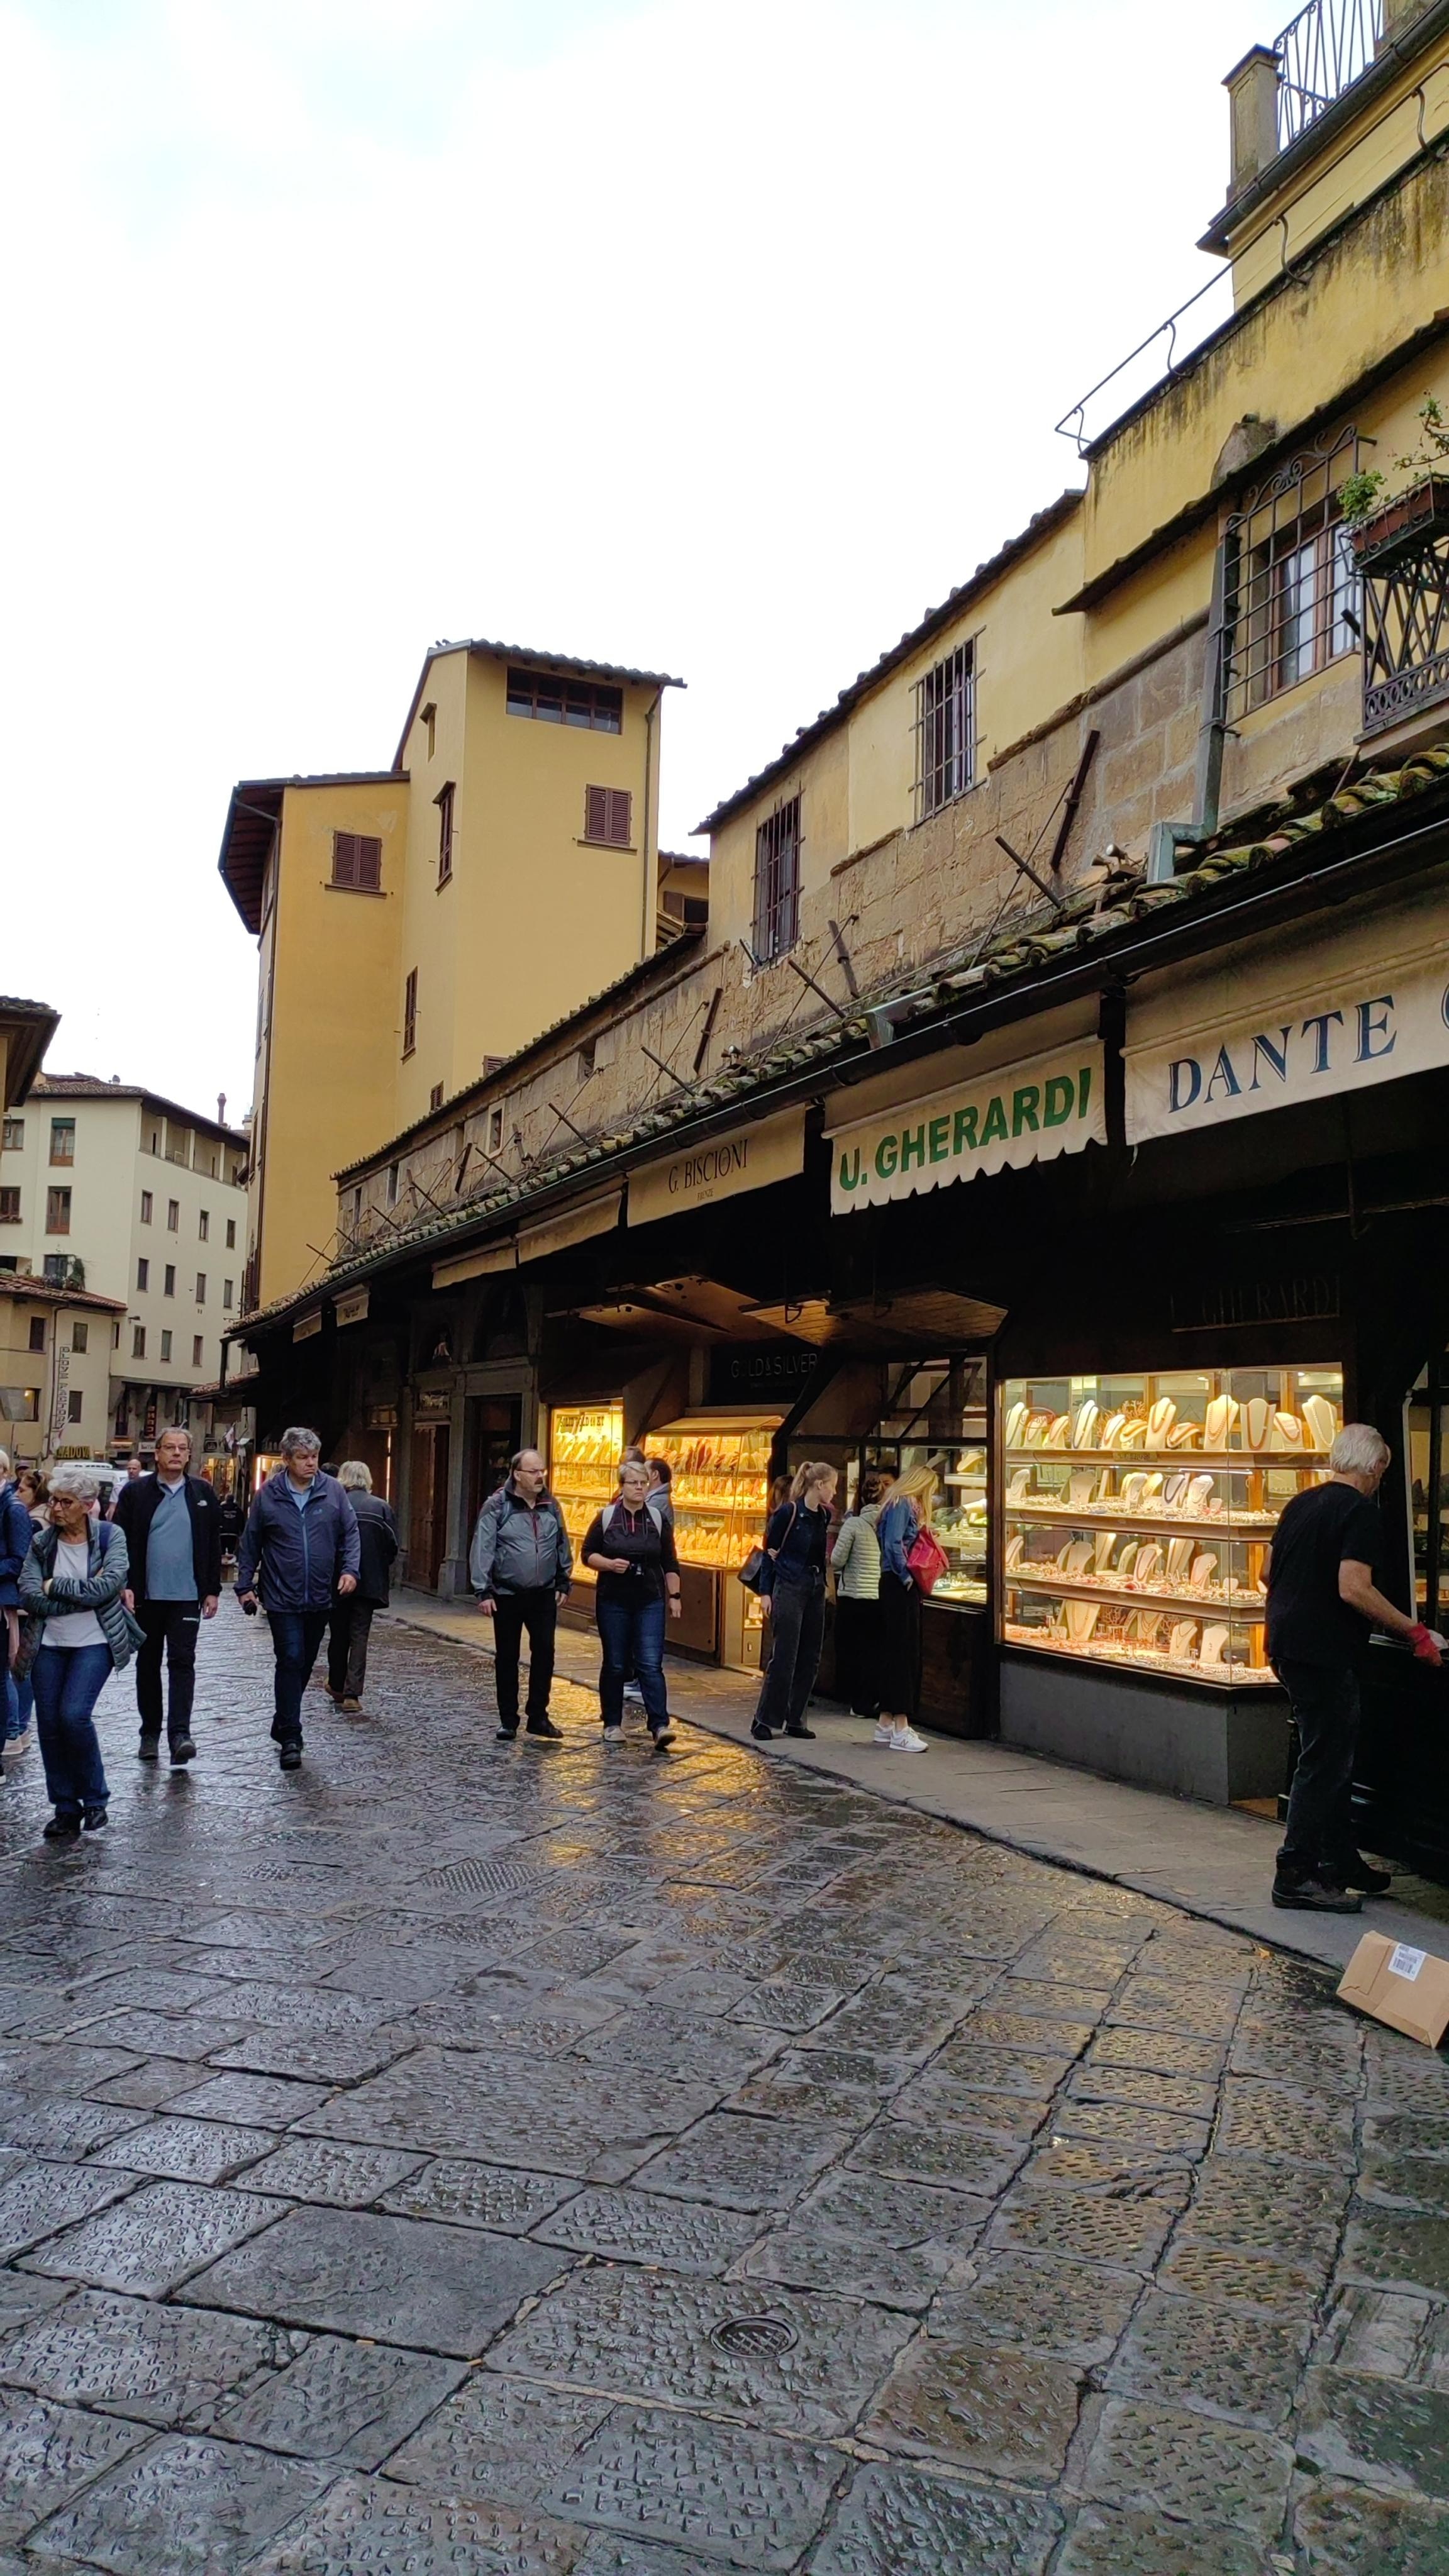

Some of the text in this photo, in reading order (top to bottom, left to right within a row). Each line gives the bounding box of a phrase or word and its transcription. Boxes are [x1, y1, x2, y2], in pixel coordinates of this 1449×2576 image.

[1168, 995, 1397, 1113] DANTE
[669, 1139, 748, 1193] G. BISCIONI
[839, 1067, 1091, 1191] U. GHERARDI
